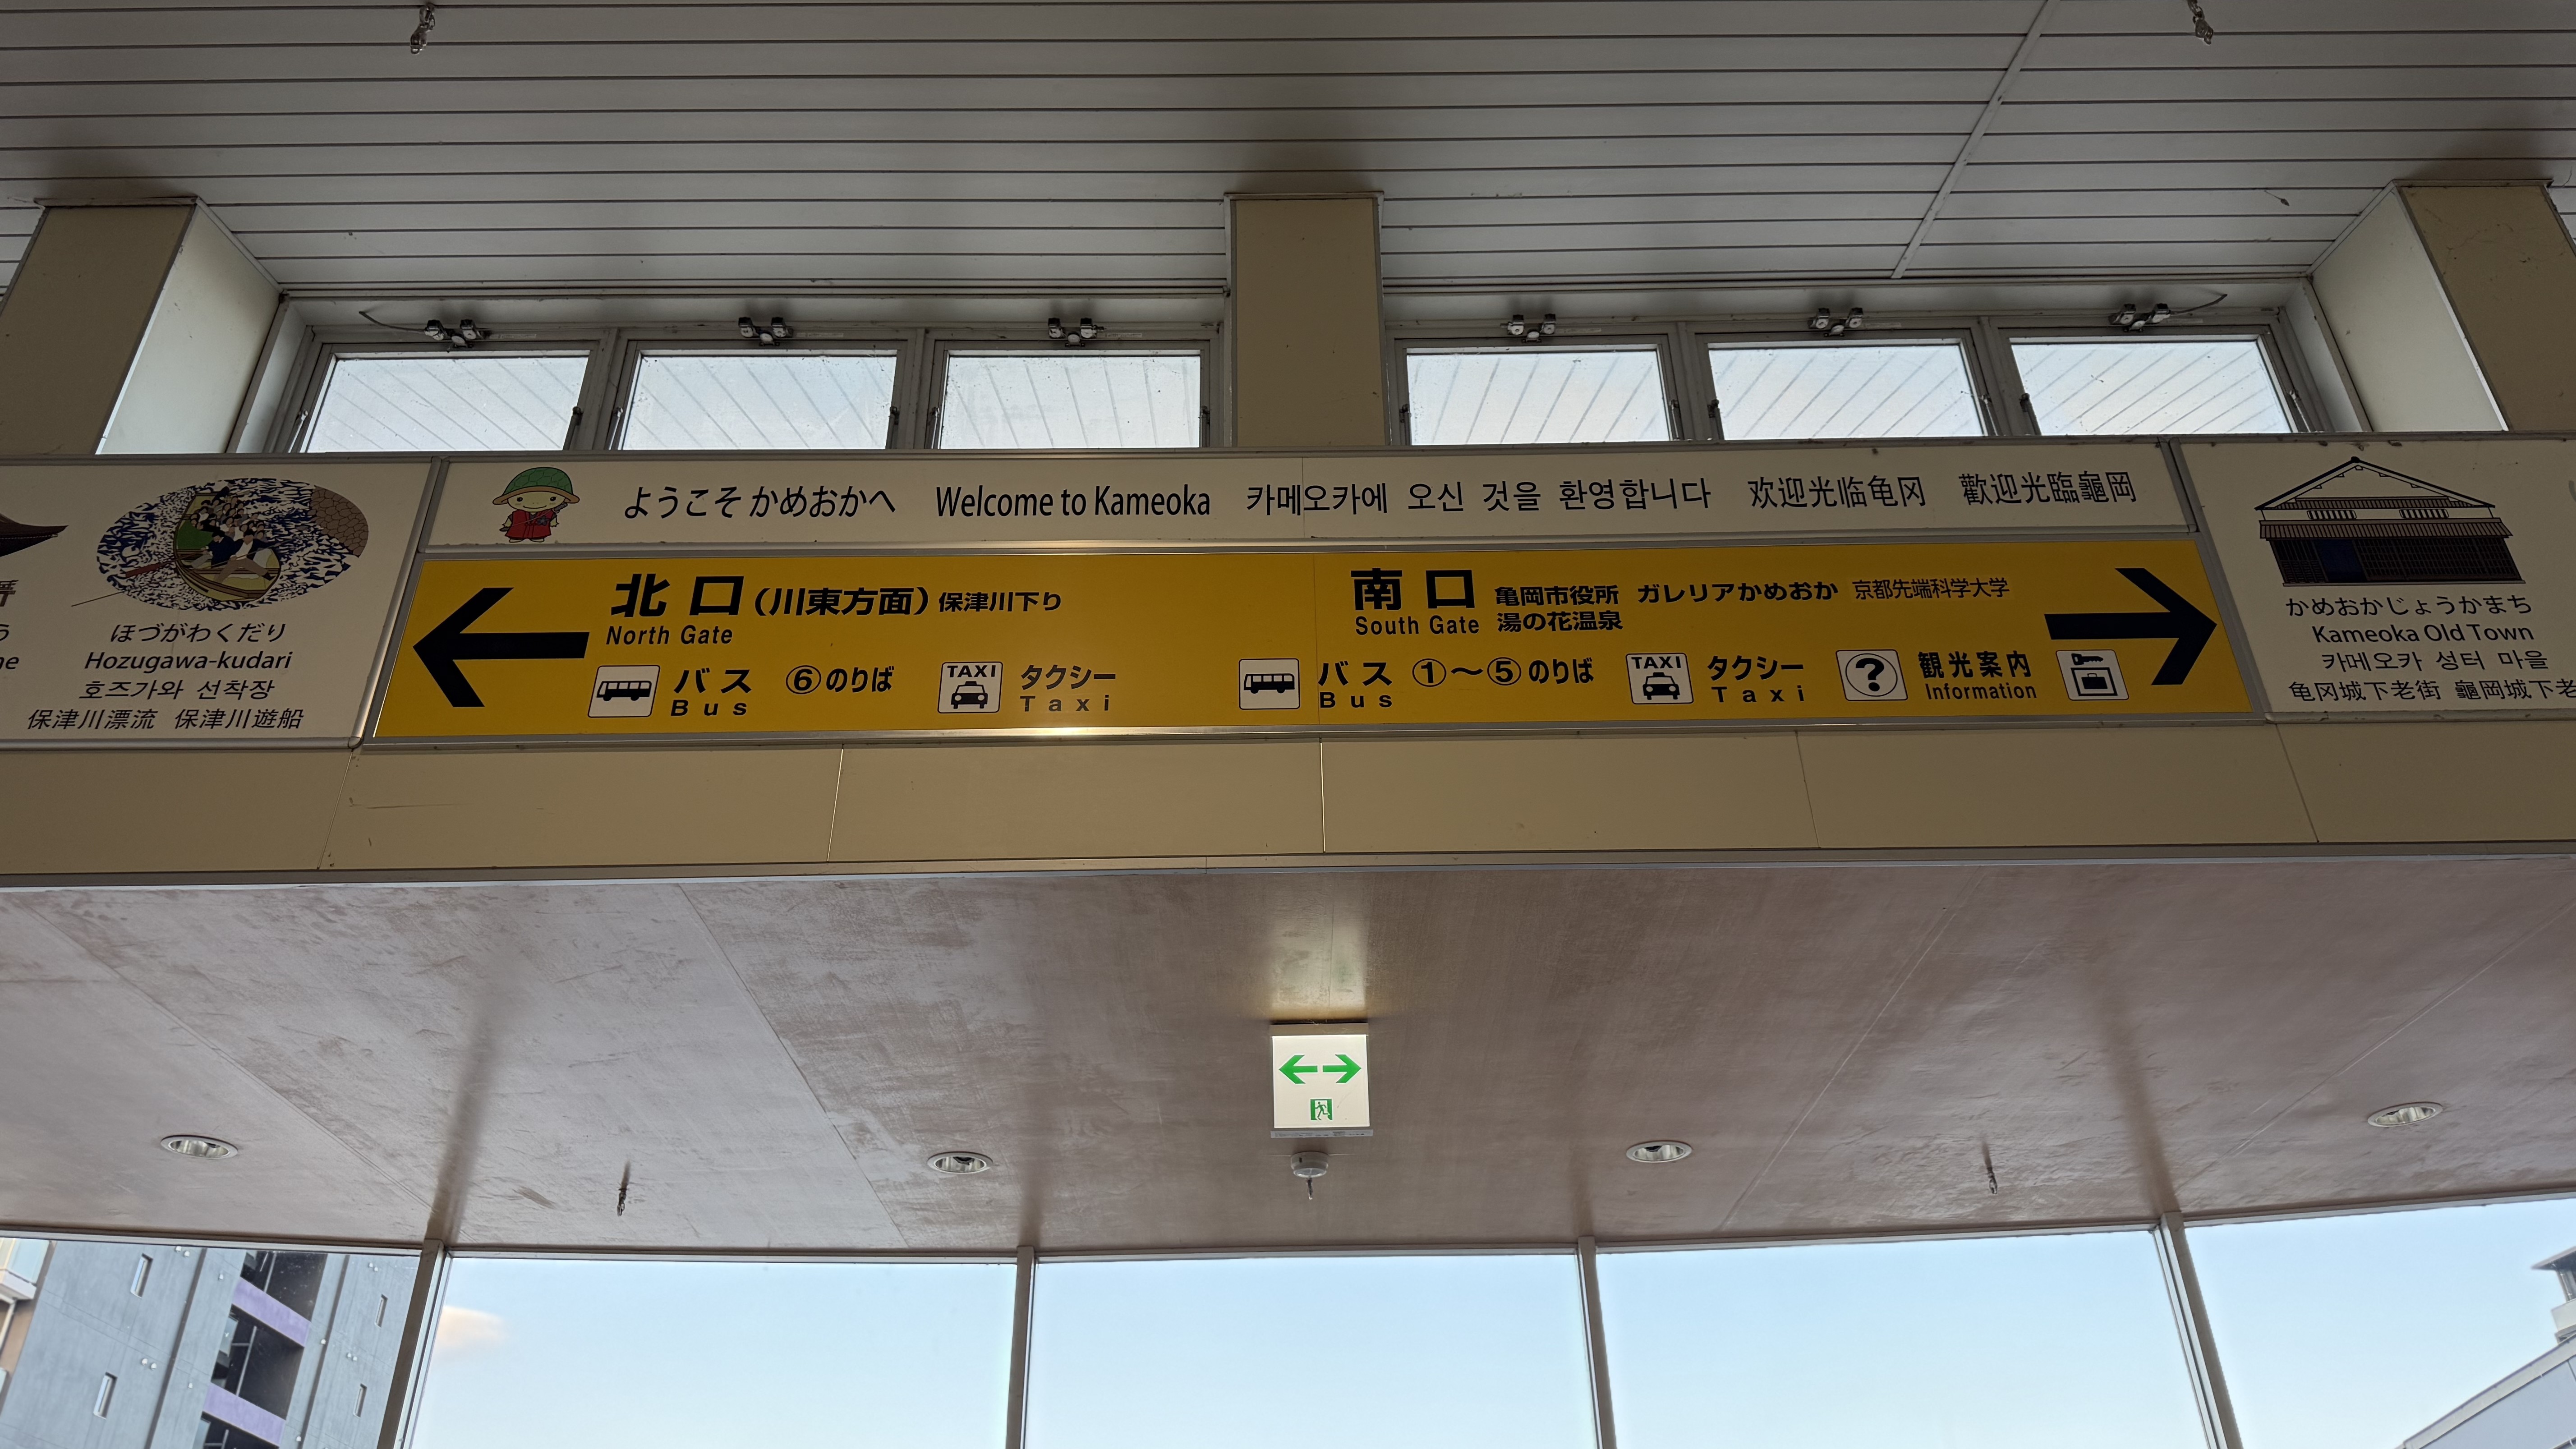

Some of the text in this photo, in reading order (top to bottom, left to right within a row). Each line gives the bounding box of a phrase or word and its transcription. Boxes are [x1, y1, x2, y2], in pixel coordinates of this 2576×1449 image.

[1247, 478, 1711, 516] 카메오카에 오신 것을 환영합니다
[1958, 470, 2137, 506] 歡迎光臨龜岡
[936, 484, 1210, 517] Welcome to Kameoka
[938, 592, 1061, 612] 保津川下り
[1494, 577, 2010, 606] 亀岡市役所 ガレリアかめおか 京都先端科学大学
[2286, 595, 2531, 616] かめおかじょうかまち
[1356, 615, 1479, 635] South Gate
[1497, 610, 1623, 632] 湯の花温泉
[110, 622, 286, 643] ほづがわくだり
[606, 625, 732, 645] North Gate
[2312, 623, 2535, 643] Kameoka Old Town
[84, 650, 293, 674] Hozugawa-kudari
[1631, 656, 1681, 669] TAXI
[1707, 655, 1804, 681] タクシー
[1918, 650, 2031, 679] 観光案内
[2322, 649, 2548, 672] 카메오카 성터 마을
[673, 667, 752, 694] バス
[947, 665, 996, 678] TAXI
[1021, 664, 1116, 690] タクシー
[1318, 661, 1392, 686] バス
[78, 680, 275, 700] 호즈가와 선착장
[1320, 692, 1392, 708] Bus
[1711, 685, 1804, 703] Taxi
[1925, 682, 2037, 700] Information
[671, 699, 747, 716] Bus
[1020, 695, 1109, 712] Taxi
[28, 708, 304, 730] 保津川漂流 保津川遊船
